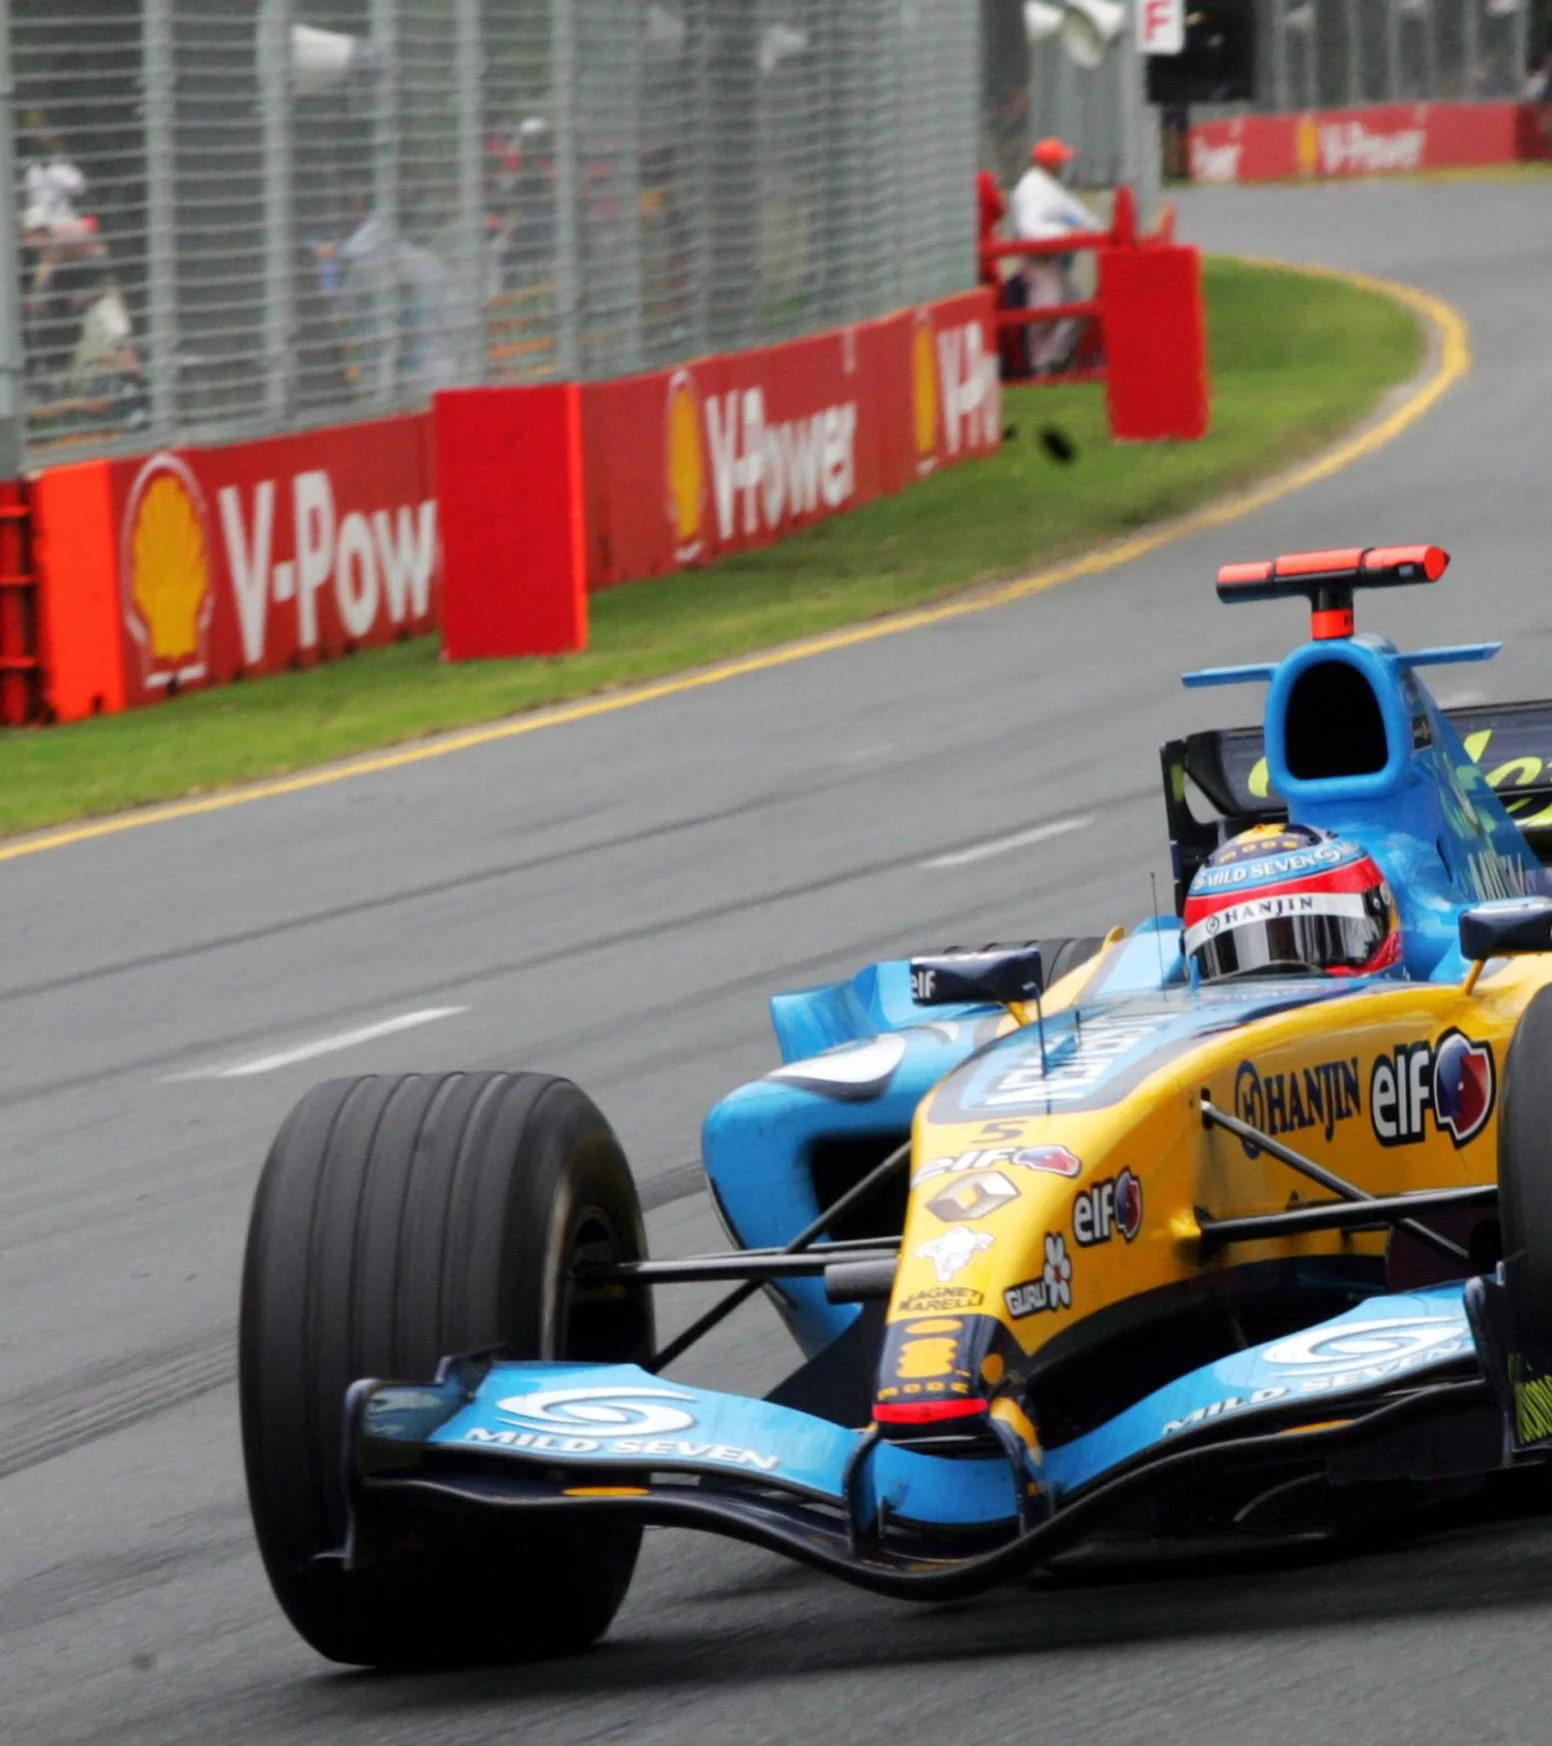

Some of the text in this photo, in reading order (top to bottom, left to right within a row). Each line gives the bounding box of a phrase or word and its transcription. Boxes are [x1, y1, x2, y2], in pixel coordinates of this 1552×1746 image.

[218, 469, 437, 663] V-Pow
[1207, 856, 1319, 888] MILD SEVEN
[1225, 897, 1313, 924] HANJIN
[1264, 1056, 1362, 1143] HANJIN
[1370, 1041, 1432, 1146] elf
[970, 1119, 1029, 1144] 5
[1072, 1178, 1116, 1246] elf
[1005, 1282, 1047, 1317] GURU
[1162, 1340, 1464, 1434] MILD SEVEN
[463, 1427, 779, 1471] MILD SEVEN
